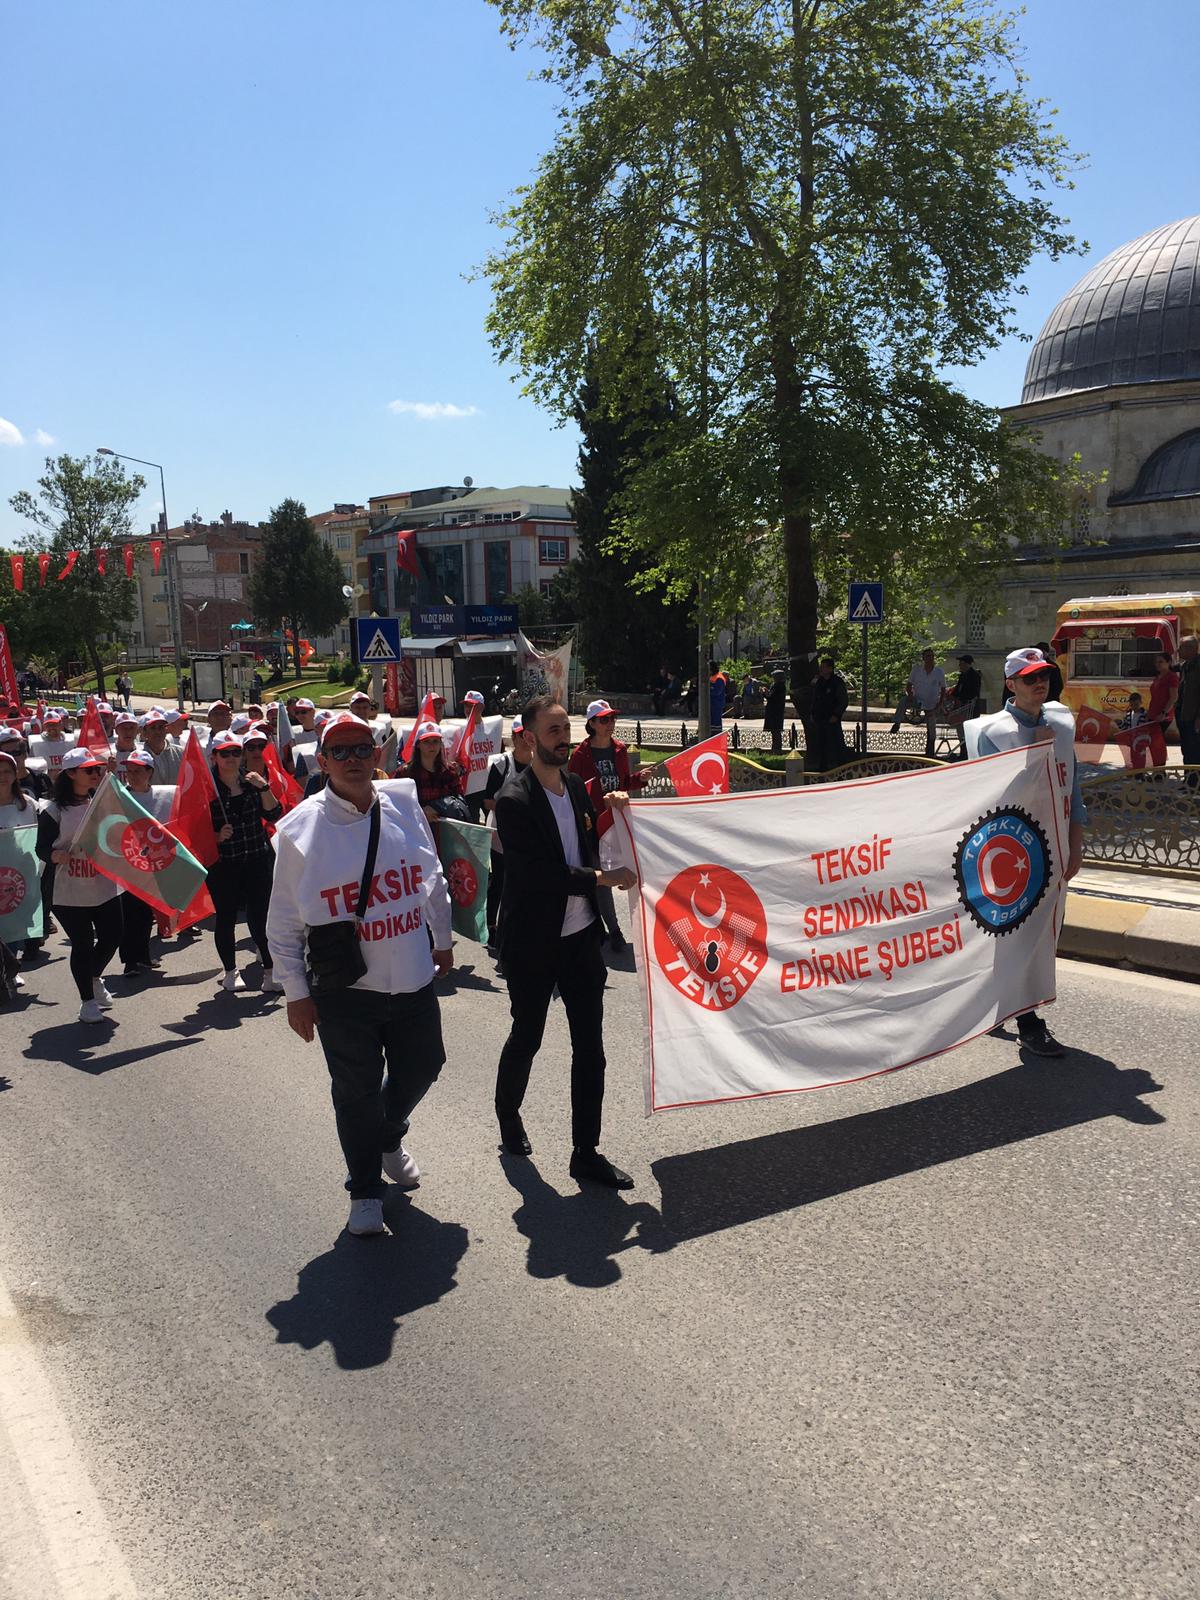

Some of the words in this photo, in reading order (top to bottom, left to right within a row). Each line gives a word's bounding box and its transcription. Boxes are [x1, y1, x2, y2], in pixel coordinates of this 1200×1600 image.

[420, 614, 438, 624] YILDIZ
[439, 614, 454, 623] PARK
[494, 615, 513, 623] PARK
[471, 738, 494, 754] EKSİF
[124, 839, 165, 872] TEKSİF
[811, 833, 892, 885] TEKSİF
[320, 859, 422, 917] TEKSİF
[803, 880, 928, 939] SENDİKASI
[356, 906, 422, 943] NDİKASI
[781, 946, 872, 993] EDİRNE
[878, 913, 964, 981] ŞUBESİ
[665, 950, 760, 1008] TEKSİF
